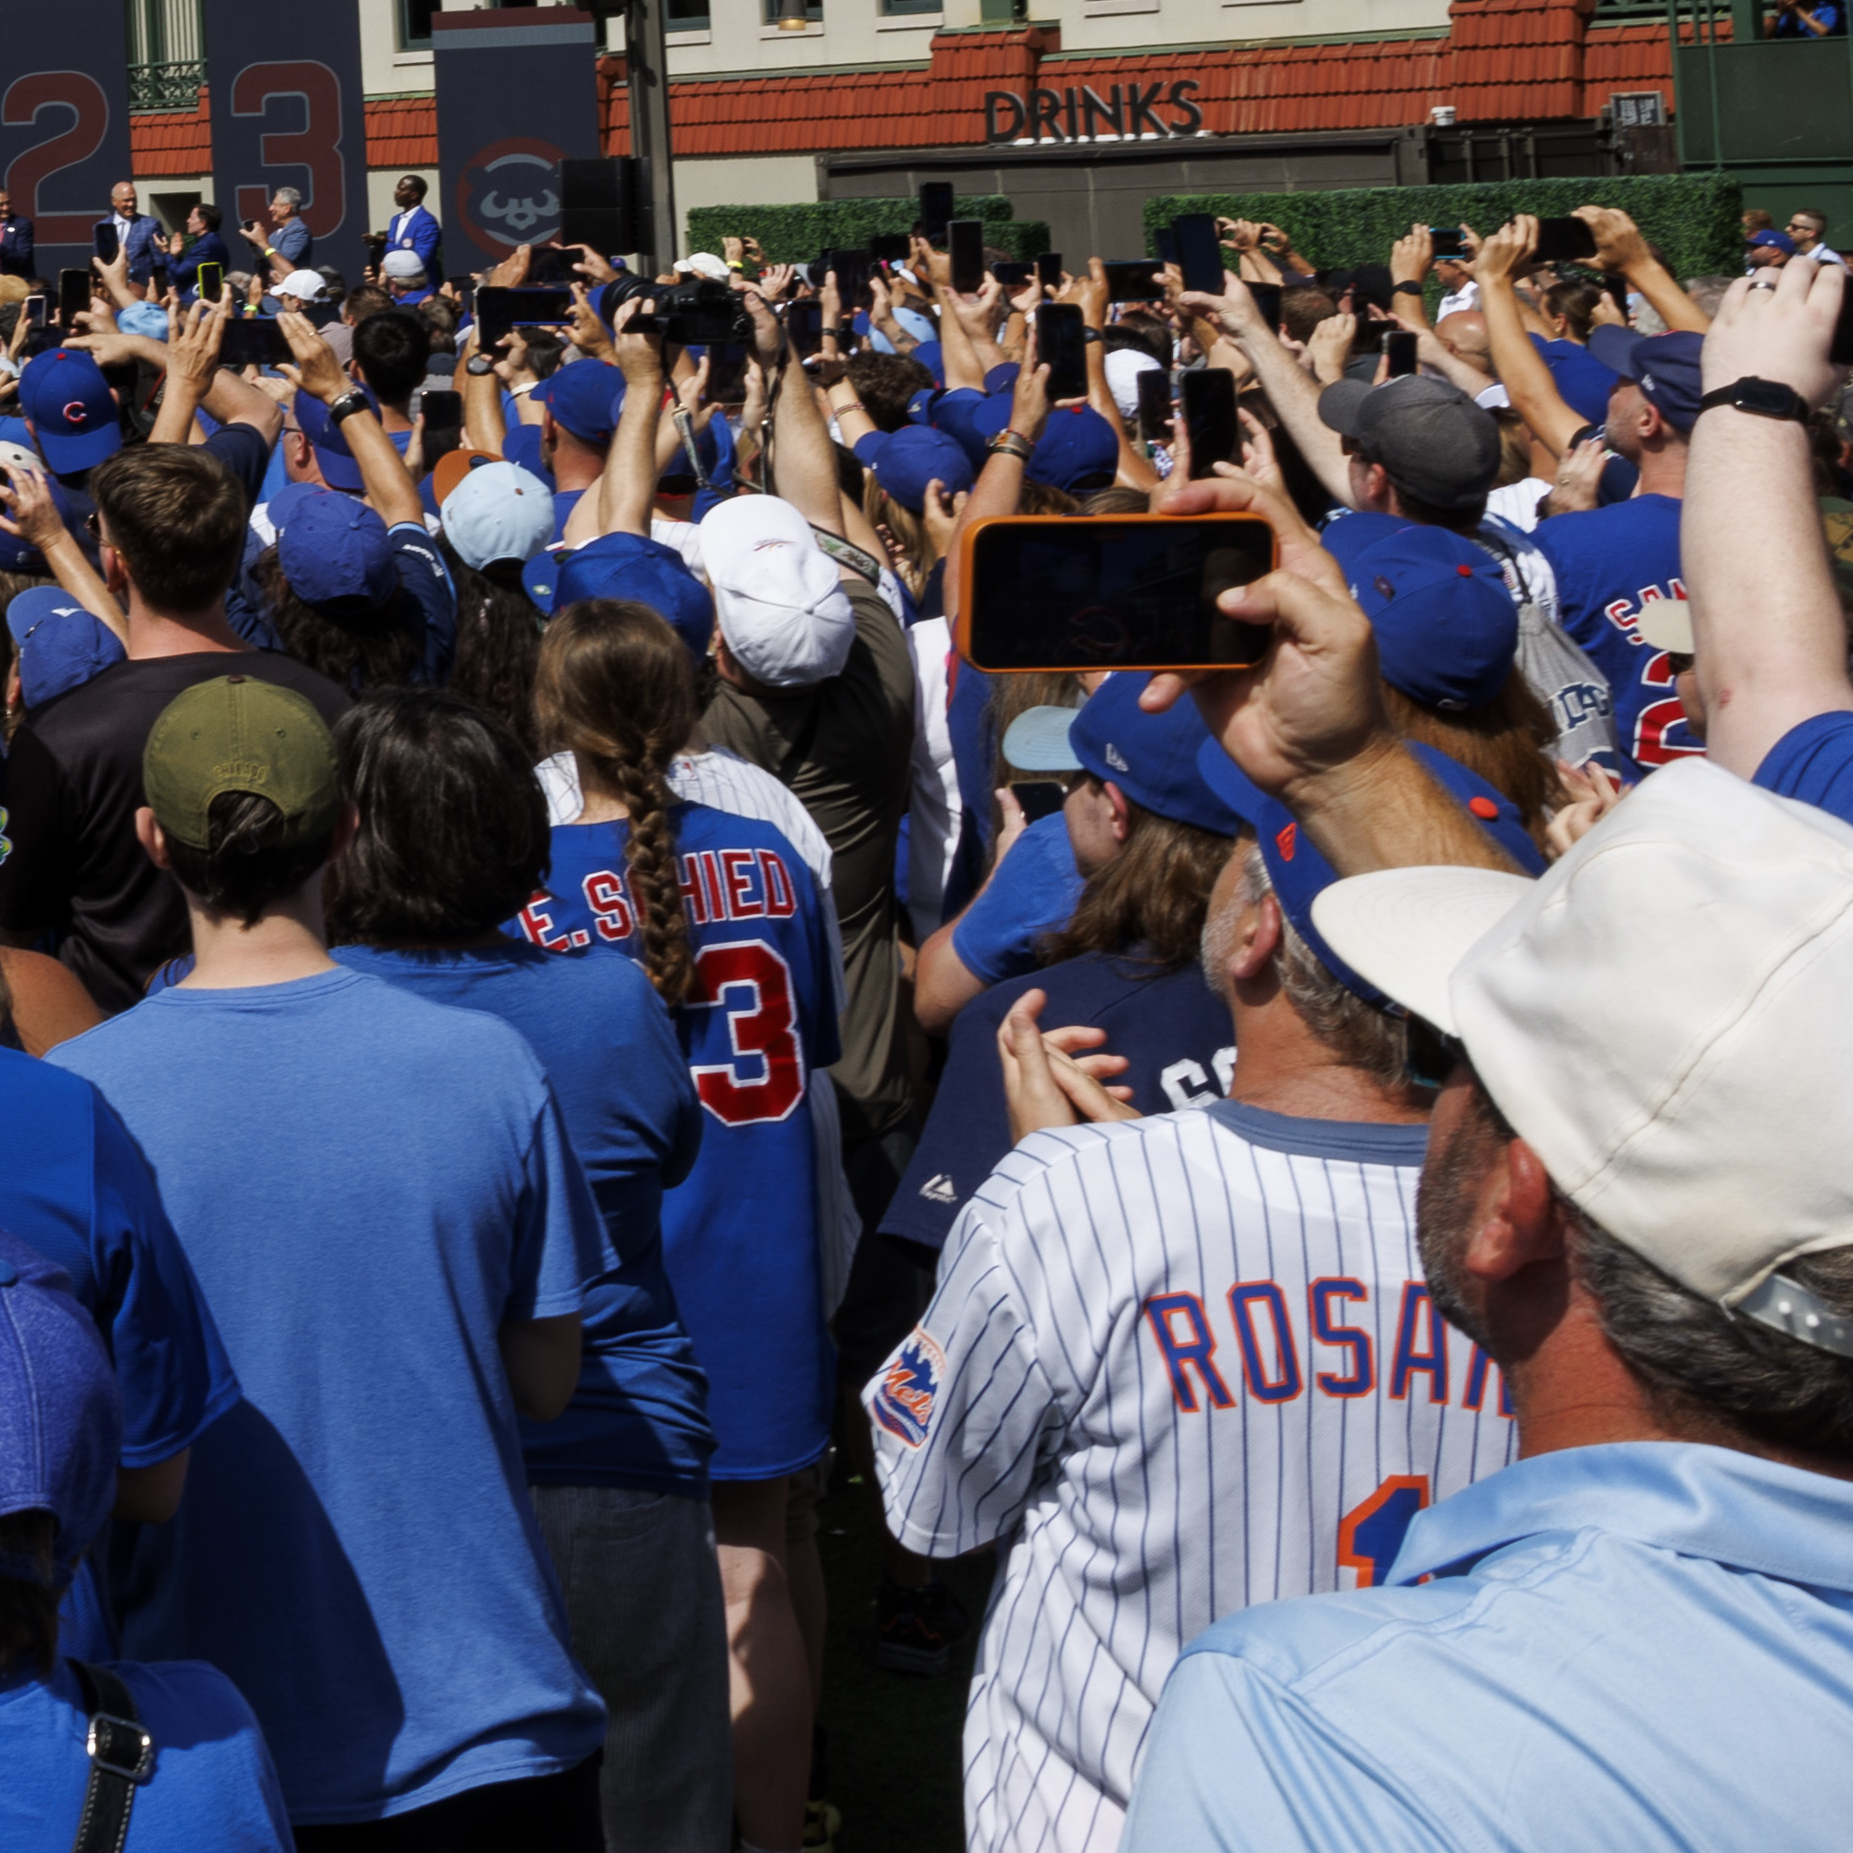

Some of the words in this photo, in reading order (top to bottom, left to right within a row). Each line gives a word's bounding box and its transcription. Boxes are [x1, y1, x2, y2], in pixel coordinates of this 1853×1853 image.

[1, 69, 111, 247] 2
[230, 59, 346, 239] 3
[984, 78, 1204, 144] DRINKS
